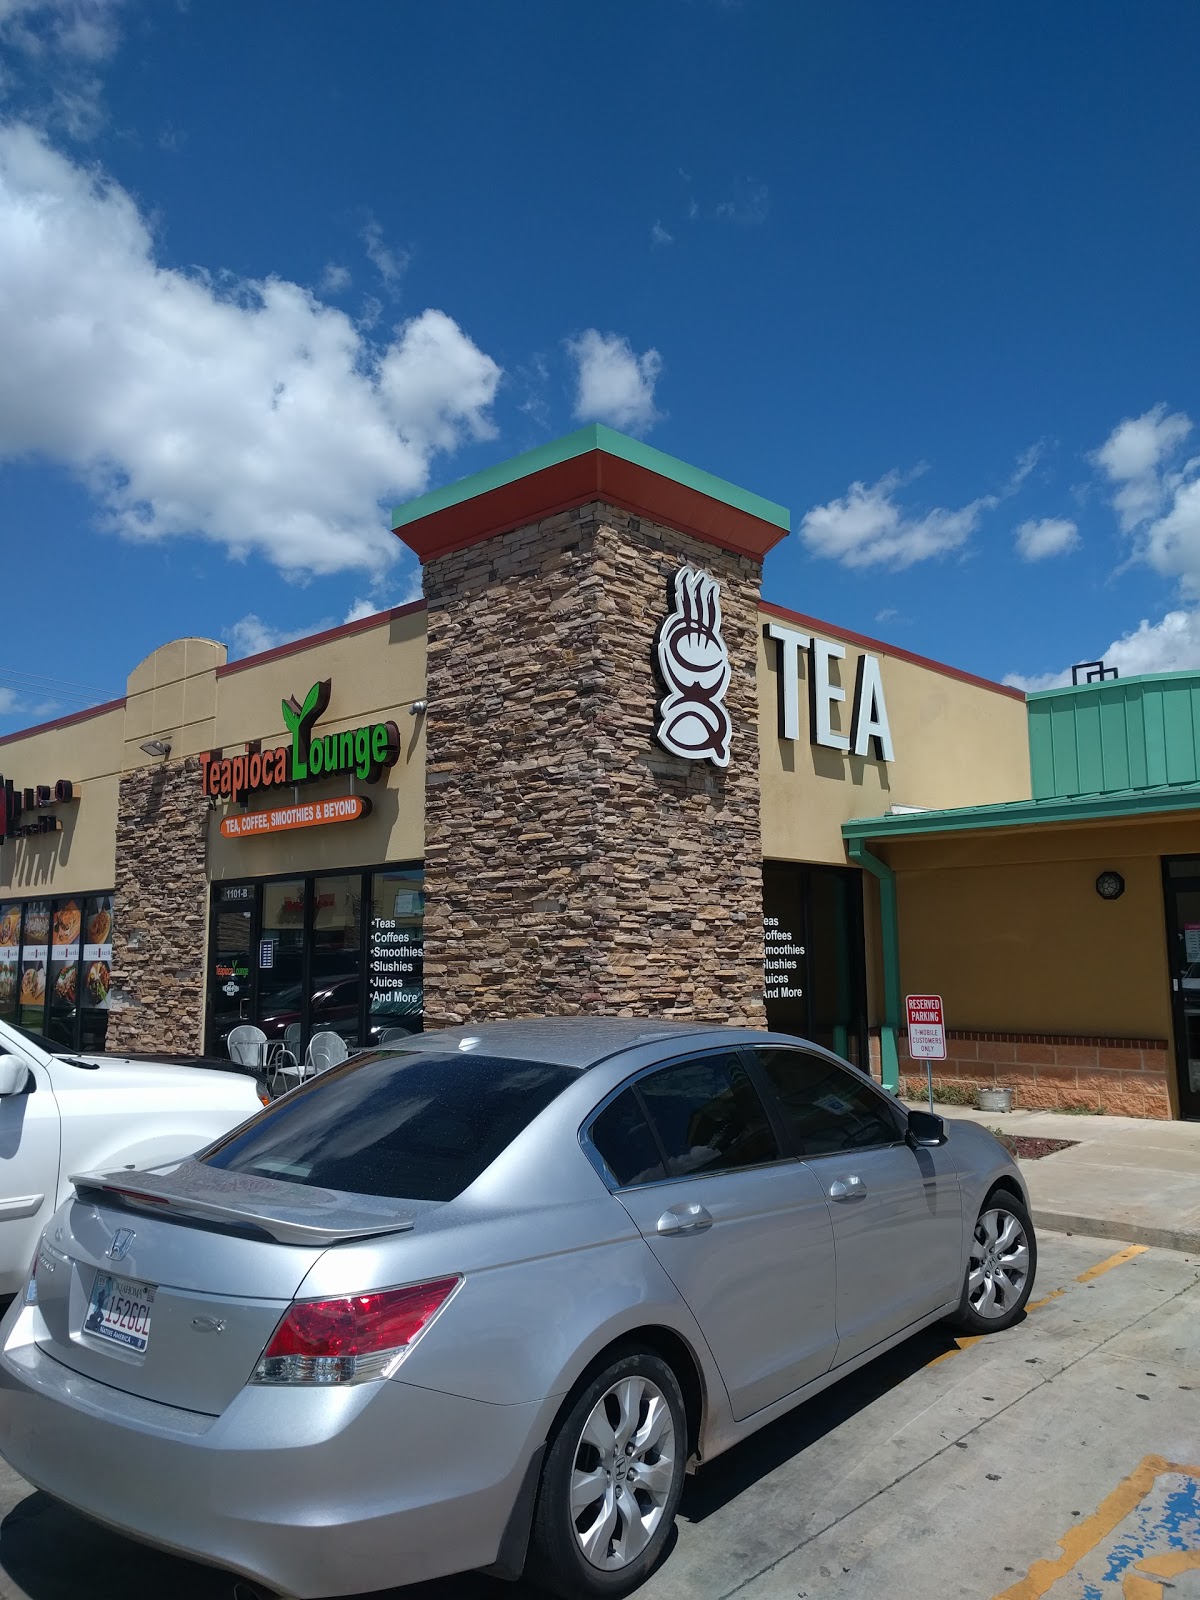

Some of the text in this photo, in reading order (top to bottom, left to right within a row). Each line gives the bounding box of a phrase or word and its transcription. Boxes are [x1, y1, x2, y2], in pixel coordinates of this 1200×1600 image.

[768, 622, 895, 762] TEA
[200, 681, 388, 802] Teapioca Lounge
[226, 799, 357, 834] TEA, COFFEE, SMOOTHIES & BEYOND
[227, 889, 248, 899] 1101-B
[763, 917, 779, 926] eas
[764, 944, 805, 955] moothies
[765, 973, 789, 984] uices
[394, 991, 418, 1003] More
[780, 987, 803, 998] More
[908, 999, 940, 1010] RESERVED
[911, 1011, 939, 1022] PARKING
[912, 1037, 942, 1045] CUSTOMERS
[105, 1295, 151, 1336] 152GCL
[100, 1326, 113, 1337] NATIVE
